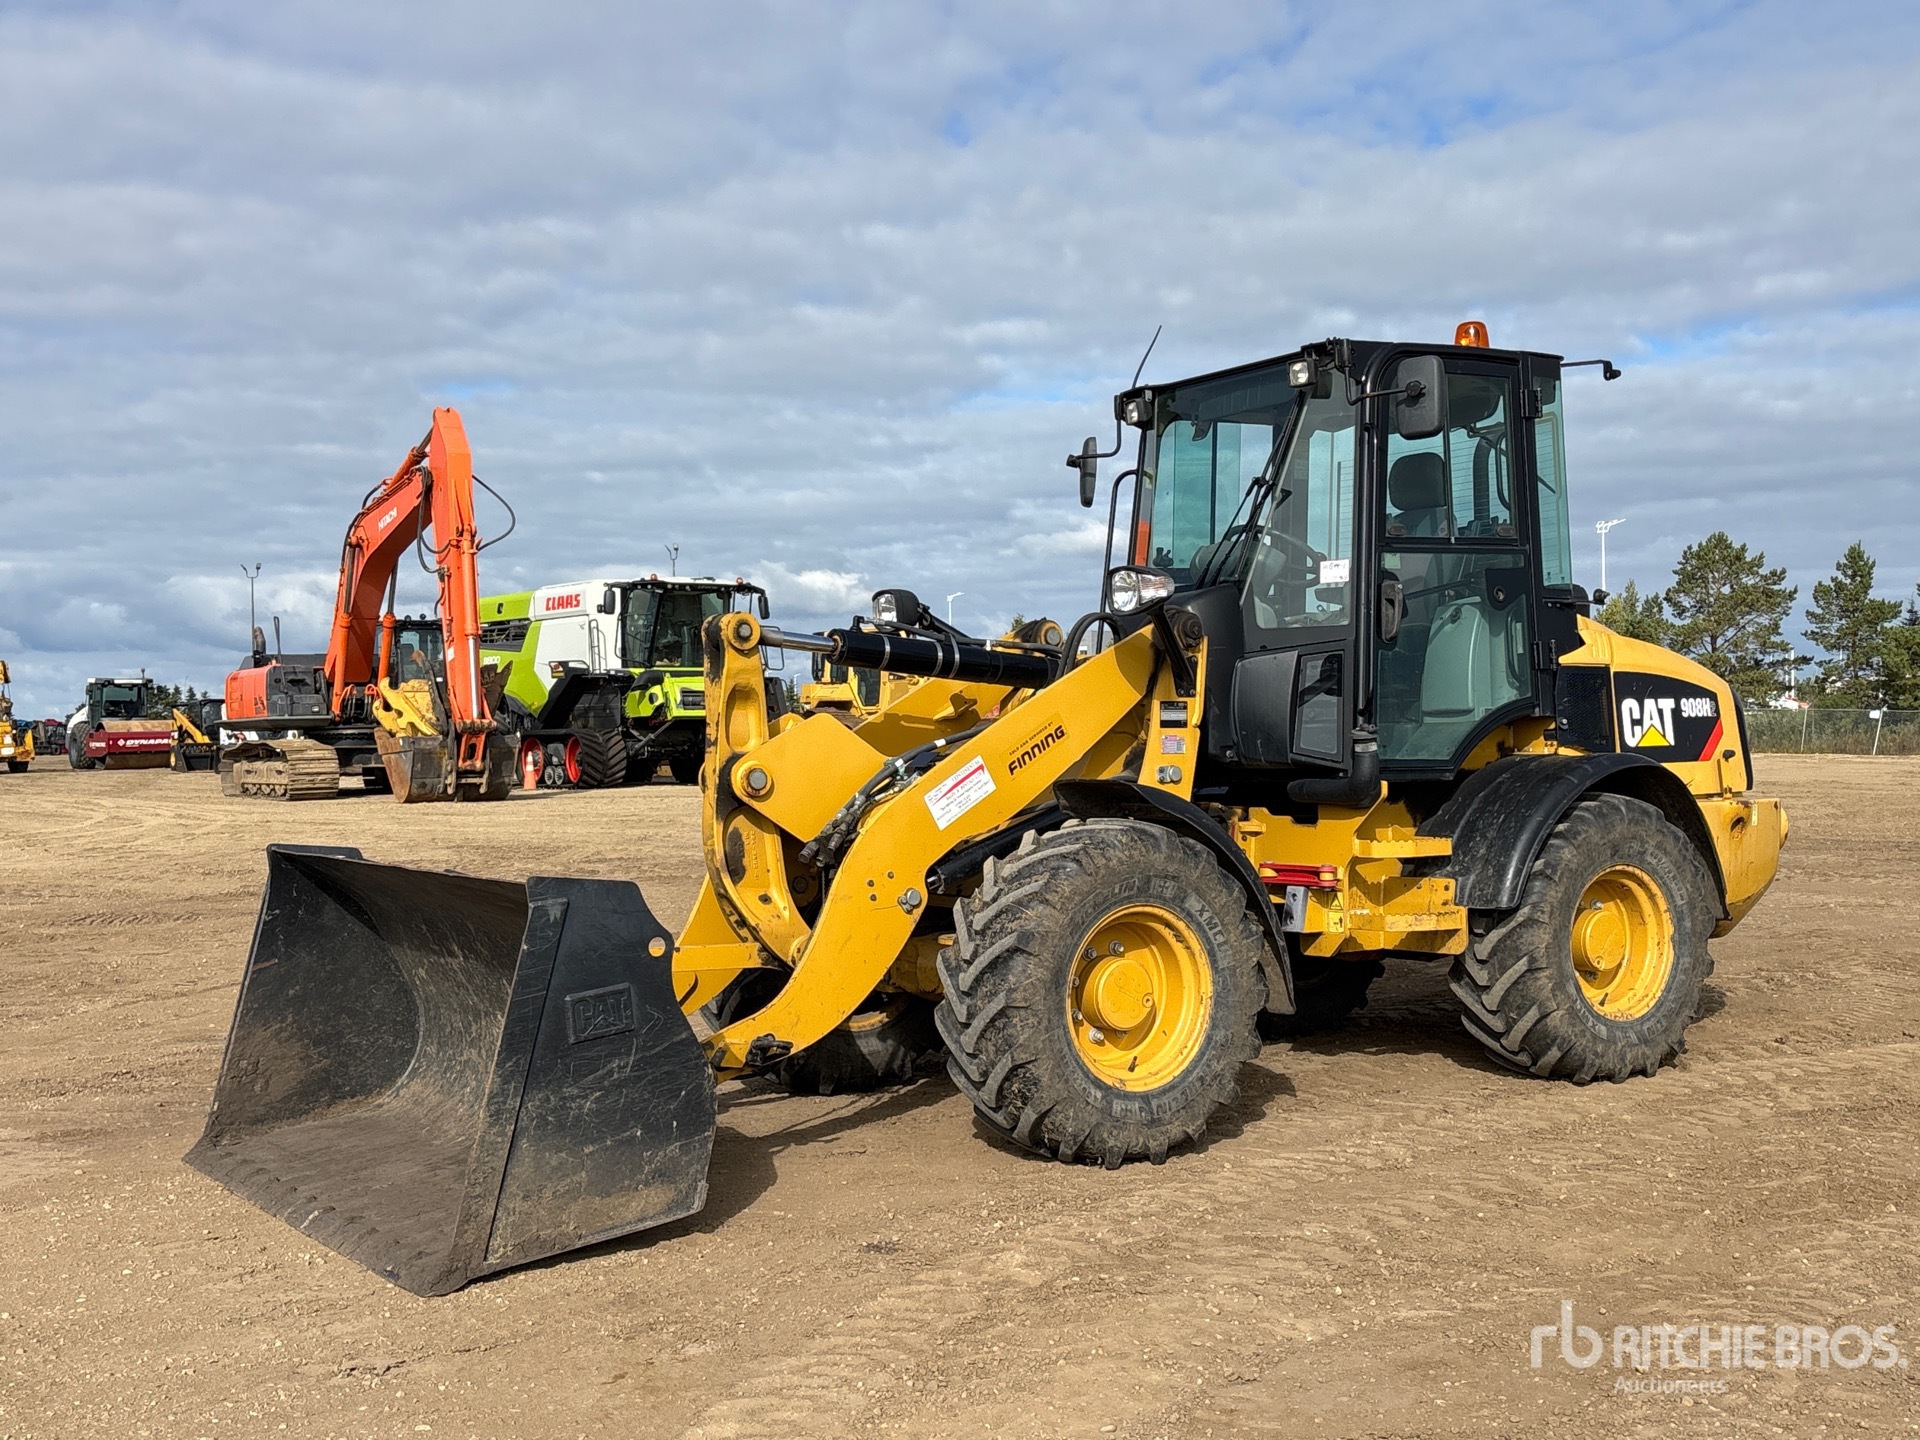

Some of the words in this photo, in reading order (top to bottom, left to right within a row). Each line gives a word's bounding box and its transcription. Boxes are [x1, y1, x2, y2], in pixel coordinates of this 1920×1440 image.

[545, 593, 581, 611] CLAAS
[1621, 698, 1675, 748] CAT
[1008, 724, 1066, 776] FINNING
[573, 991, 629, 1035] CAT
